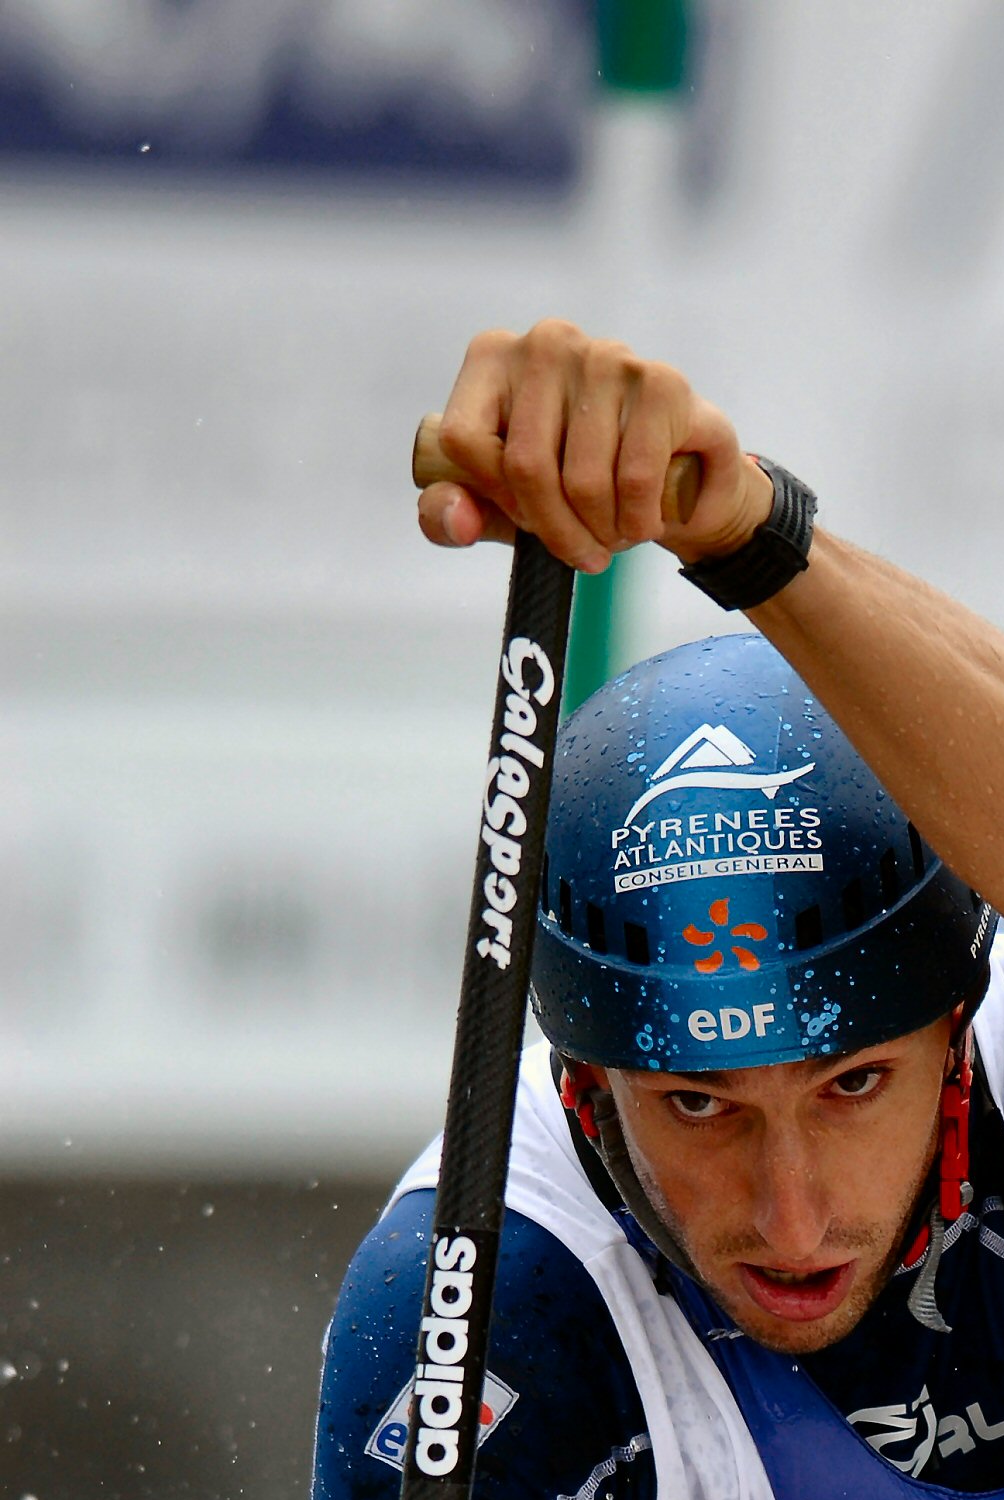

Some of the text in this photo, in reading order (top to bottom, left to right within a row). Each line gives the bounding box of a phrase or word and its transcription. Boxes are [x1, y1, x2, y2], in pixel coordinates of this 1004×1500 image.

[611, 808, 821, 849] PYRENEES
[614, 829, 823, 870] ATLANTIQUES
[618, 857, 819, 889] CONSEIL GENERAL
[688, 1003, 776, 1041] eDF
[415, 1236, 477, 1477] adidas
